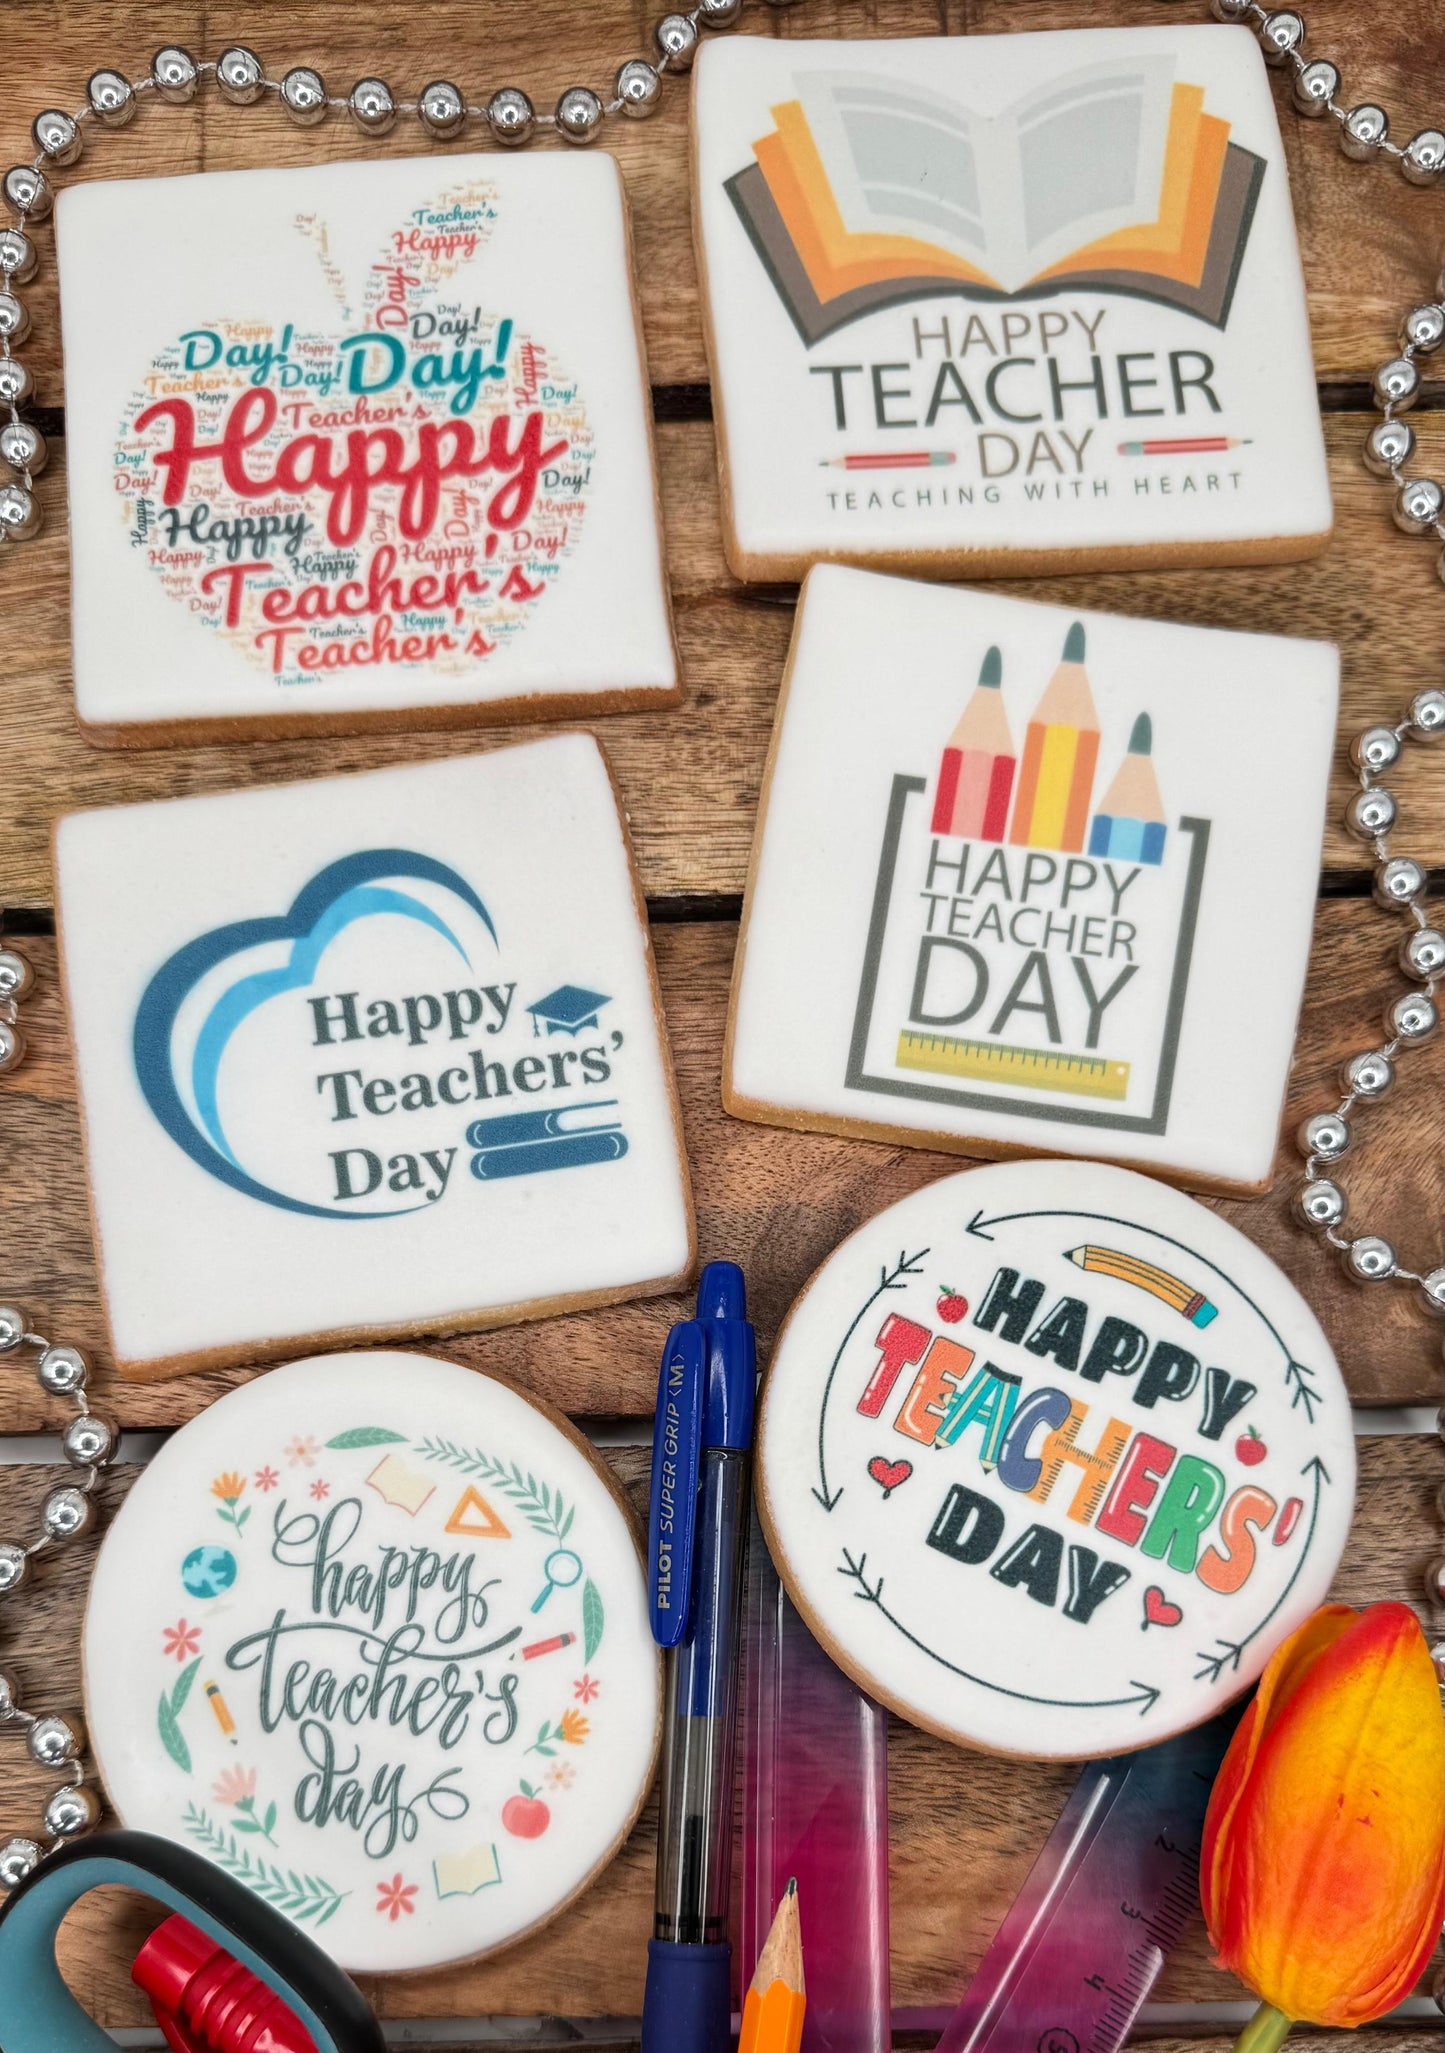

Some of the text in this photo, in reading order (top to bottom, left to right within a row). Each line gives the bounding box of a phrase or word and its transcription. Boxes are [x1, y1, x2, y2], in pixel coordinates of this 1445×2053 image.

[412, 201, 497, 226] Teacher's
[437, 221, 483, 234] Teacher's
[391, 228, 481, 260] Happy
[427, 259, 459, 278] Day!
[371, 265, 420, 330] Day!
[437, 303, 462, 317] Day!
[224, 323, 273, 341] Happy
[409, 306, 481, 348] Day!
[912, 309, 1106, 359] HAPPY
[179, 323, 294, 386] Day!
[295, 342, 335, 357] Happy
[408, 340, 443, 352] Happy
[152, 359, 179, 370] Happy
[278, 359, 343, 397] Day!
[304, 359, 333, 370] Happy
[340, 318, 514, 415] Day!
[513, 341, 547, 409] Happy
[142, 367, 246, 396] Teacher's
[541, 384, 578, 404] Day!
[809, 350, 1223, 431] TEACHER
[196, 391, 229, 405] Happy
[281, 391, 432, 431] Teacher's
[198, 407, 222, 422] Day!
[546, 408, 587, 430] Day!
[113, 449, 146, 469] Day!
[134, 386, 569, 548] Happy
[571, 449, 596, 463] Day!
[976, 428, 1094, 479] DAY
[113, 470, 159, 496] Day!
[189, 482, 222, 500] Day!
[469, 476, 493, 492] Day!
[541, 466, 590, 495] Day!
[827, 472, 1243, 511] TEACHING WITH HEART
[235, 495, 316, 518] Teacher's
[441, 487, 480, 541] Day!
[536, 498, 586, 518] Happy
[129, 497, 156, 549] Happy
[158, 503, 314, 562] Happy
[313, 547, 361, 562] Teacher's
[400, 541, 479, 572] Happy
[511, 524, 568, 560] Day!
[148, 548, 206, 570] Happy
[290, 555, 359, 582] Happy
[526, 561, 560, 576] Happy
[201, 532, 546, 629] Teacher's
[189, 595, 222, 616] Day!
[309, 622, 367, 639] Teacher's
[401, 612, 446, 632] Happy
[255, 608, 497, 674] Teacher's
[925, 839, 1142, 916] HAPPY
[920, 892, 1137, 962] TEACHER
[908, 935, 1140, 1049] DAY
[307, 981, 518, 1047] Happy
[317, 1030, 624, 1122] Teachers'
[327, 1147, 458, 1201] Day
[972, 1266, 1257, 1441] HAPPY
[663, 1403, 681, 1457] GRIP
[856, 1312, 1304, 1594] TEACHERS'
[659, 1464, 676, 1534] SUPER
[925, 1483, 1131, 1625] DAY
[271, 1497, 501, 1644] happy
[657, 1540, 673, 1609] PILOT
[225, 1608, 523, 1750] teacher's
[294, 1719, 469, 1859] day
[1155, 1834, 1175, 1852] 2
[1120, 1901, 1141, 1920] 3
[1083, 1974, 1105, 1991] 4
